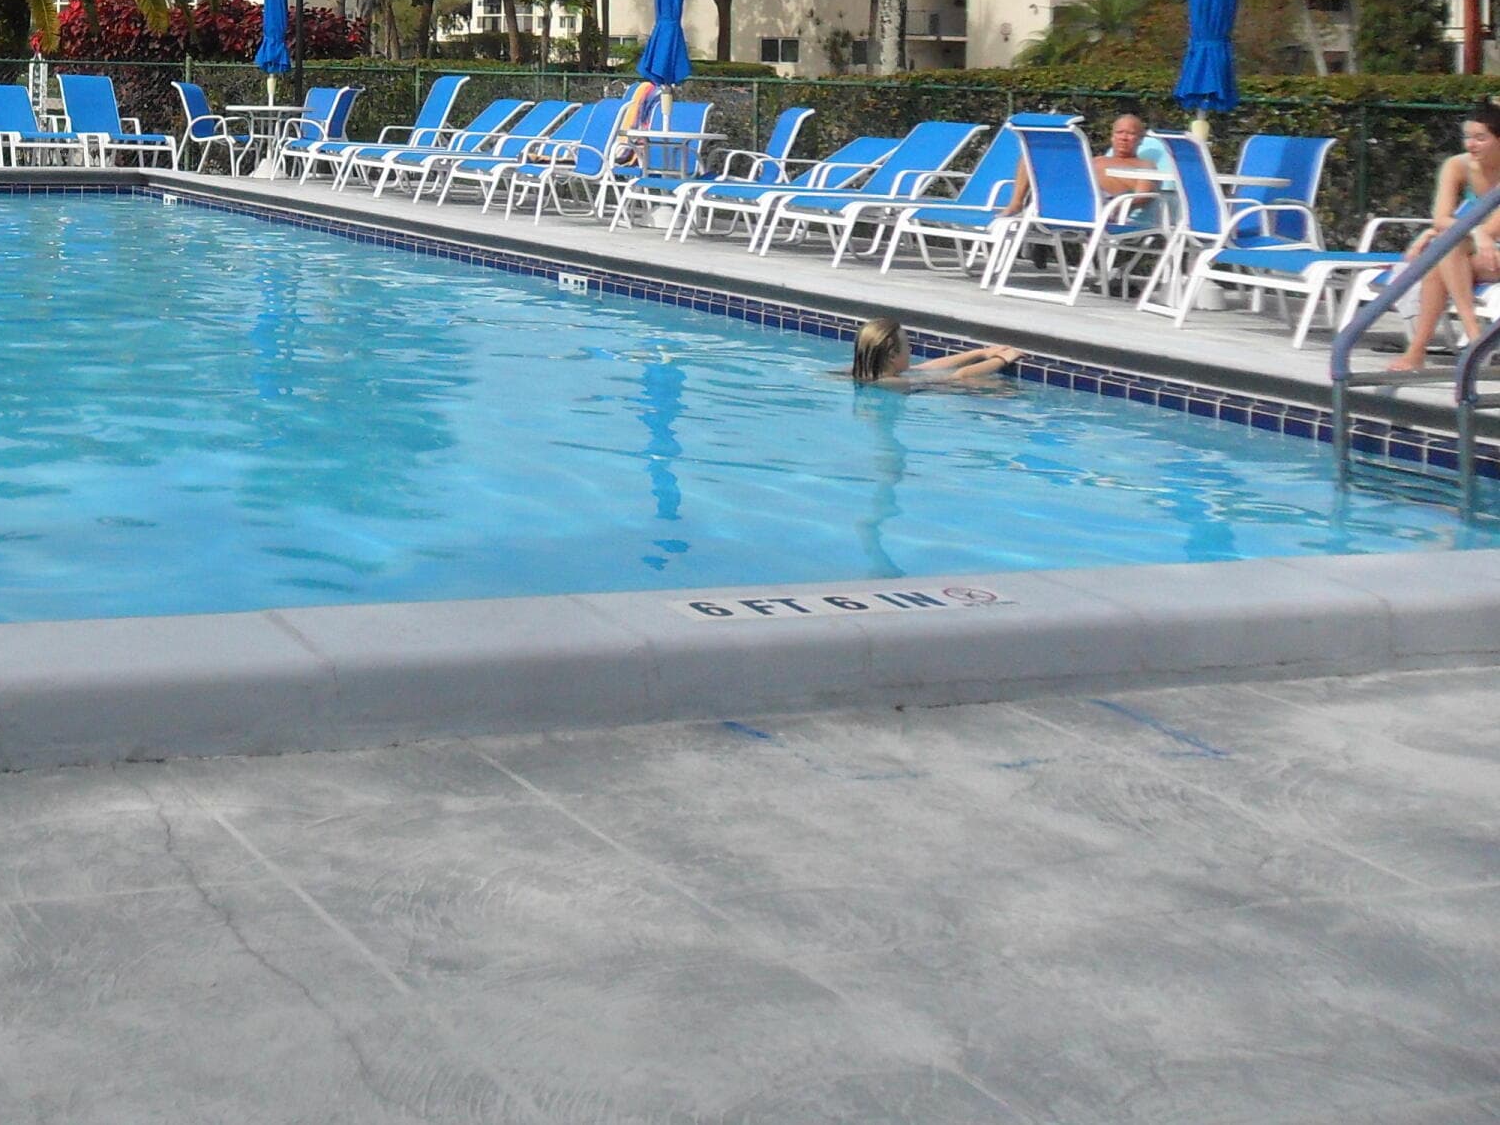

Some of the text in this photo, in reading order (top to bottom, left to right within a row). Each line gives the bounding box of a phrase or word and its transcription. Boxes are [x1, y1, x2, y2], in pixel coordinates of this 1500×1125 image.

[688, 601, 734, 617] 6
[737, 597, 811, 615] FT
[822, 596, 869, 610] 6
[873, 591, 947, 608] IN
